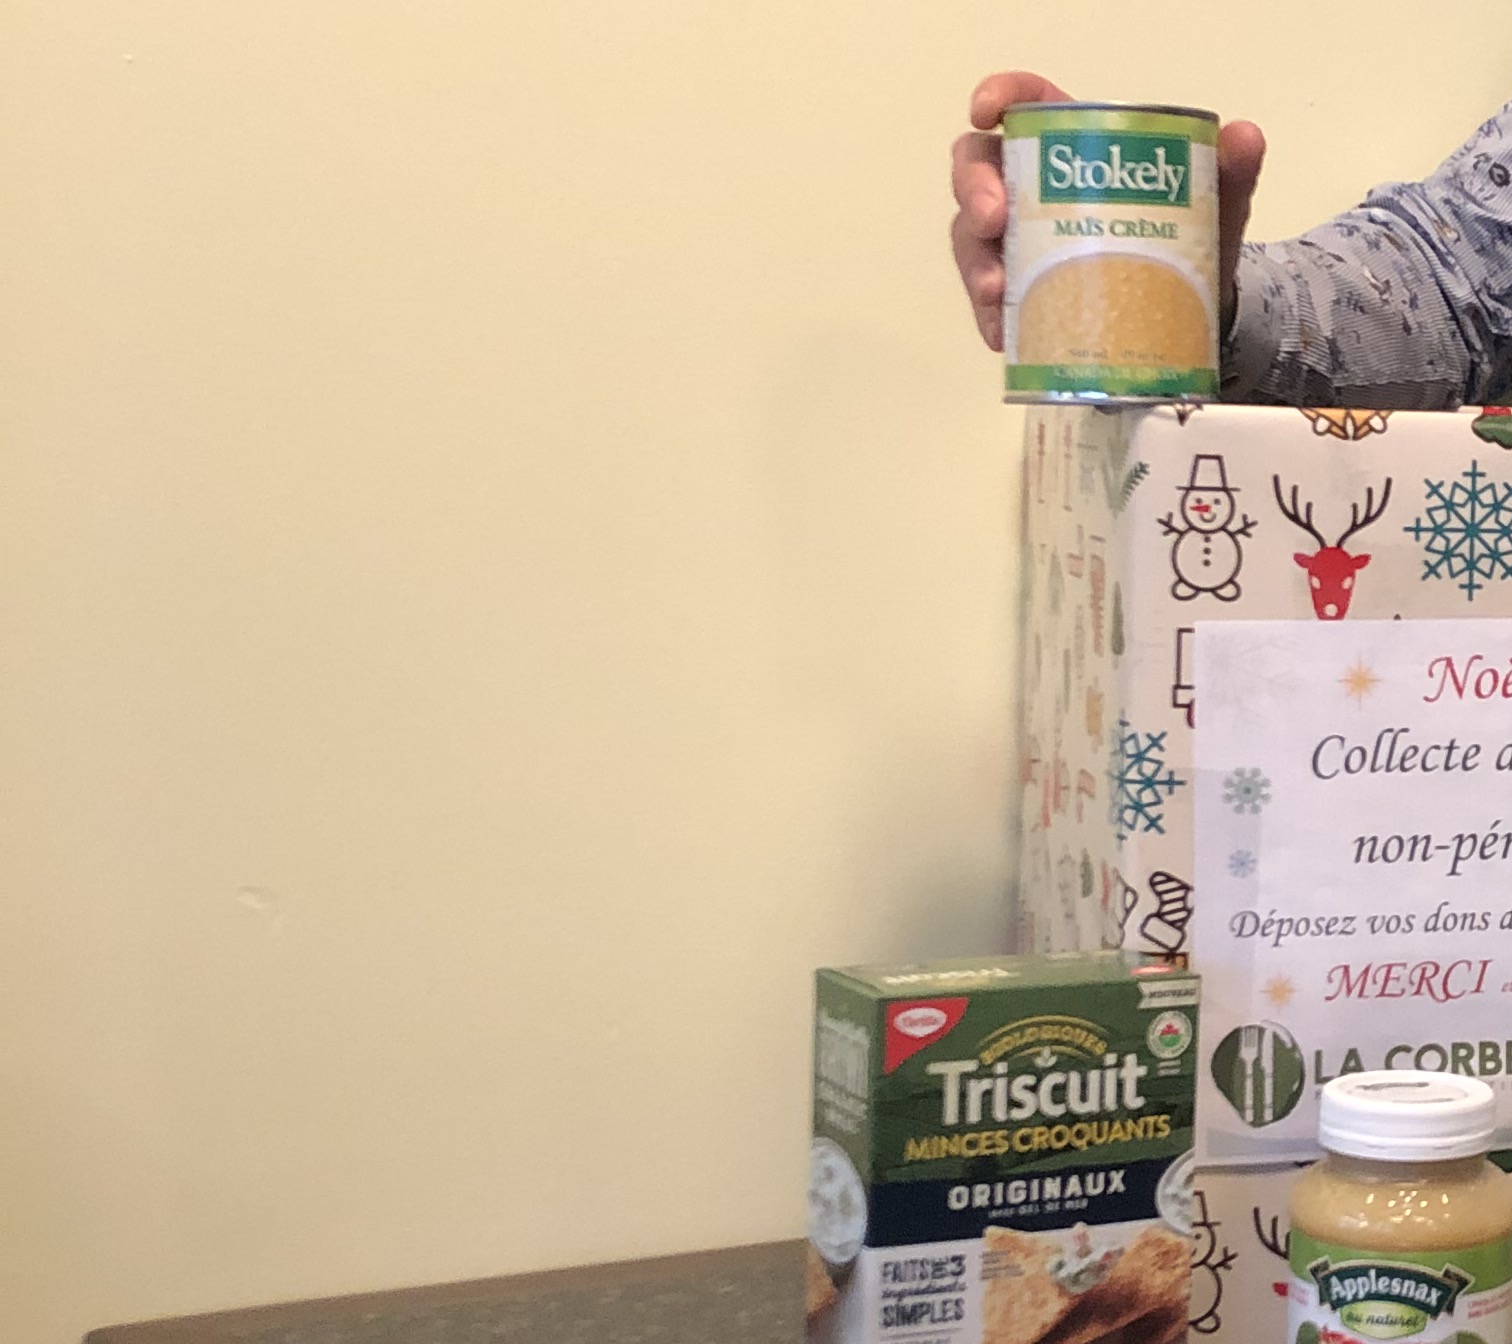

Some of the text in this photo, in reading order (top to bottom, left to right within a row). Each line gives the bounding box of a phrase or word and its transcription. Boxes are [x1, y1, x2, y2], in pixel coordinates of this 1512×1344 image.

[1048, 143, 1186, 202] Stokely
[1110, 218, 1179, 239] CRÈME
[1311, 728, 1481, 780] Collecte
[1229, 908, 1357, 947] Déposez
[1367, 914, 1415, 935] vos
[1424, 901, 1491, 933] dons
[1324, 958, 1493, 1003] MERCI
[1314, 1047, 1366, 1084] LA
[925, 1052, 1148, 1126] Triscuit
[903, 1114, 1171, 1161] MINCES CROQUANTS
[946, 1169, 1128, 1211] ORIGINAUX
[1330, 1268, 1443, 1305] Applesnax
[880, 1297, 965, 1328] SIMPLES
